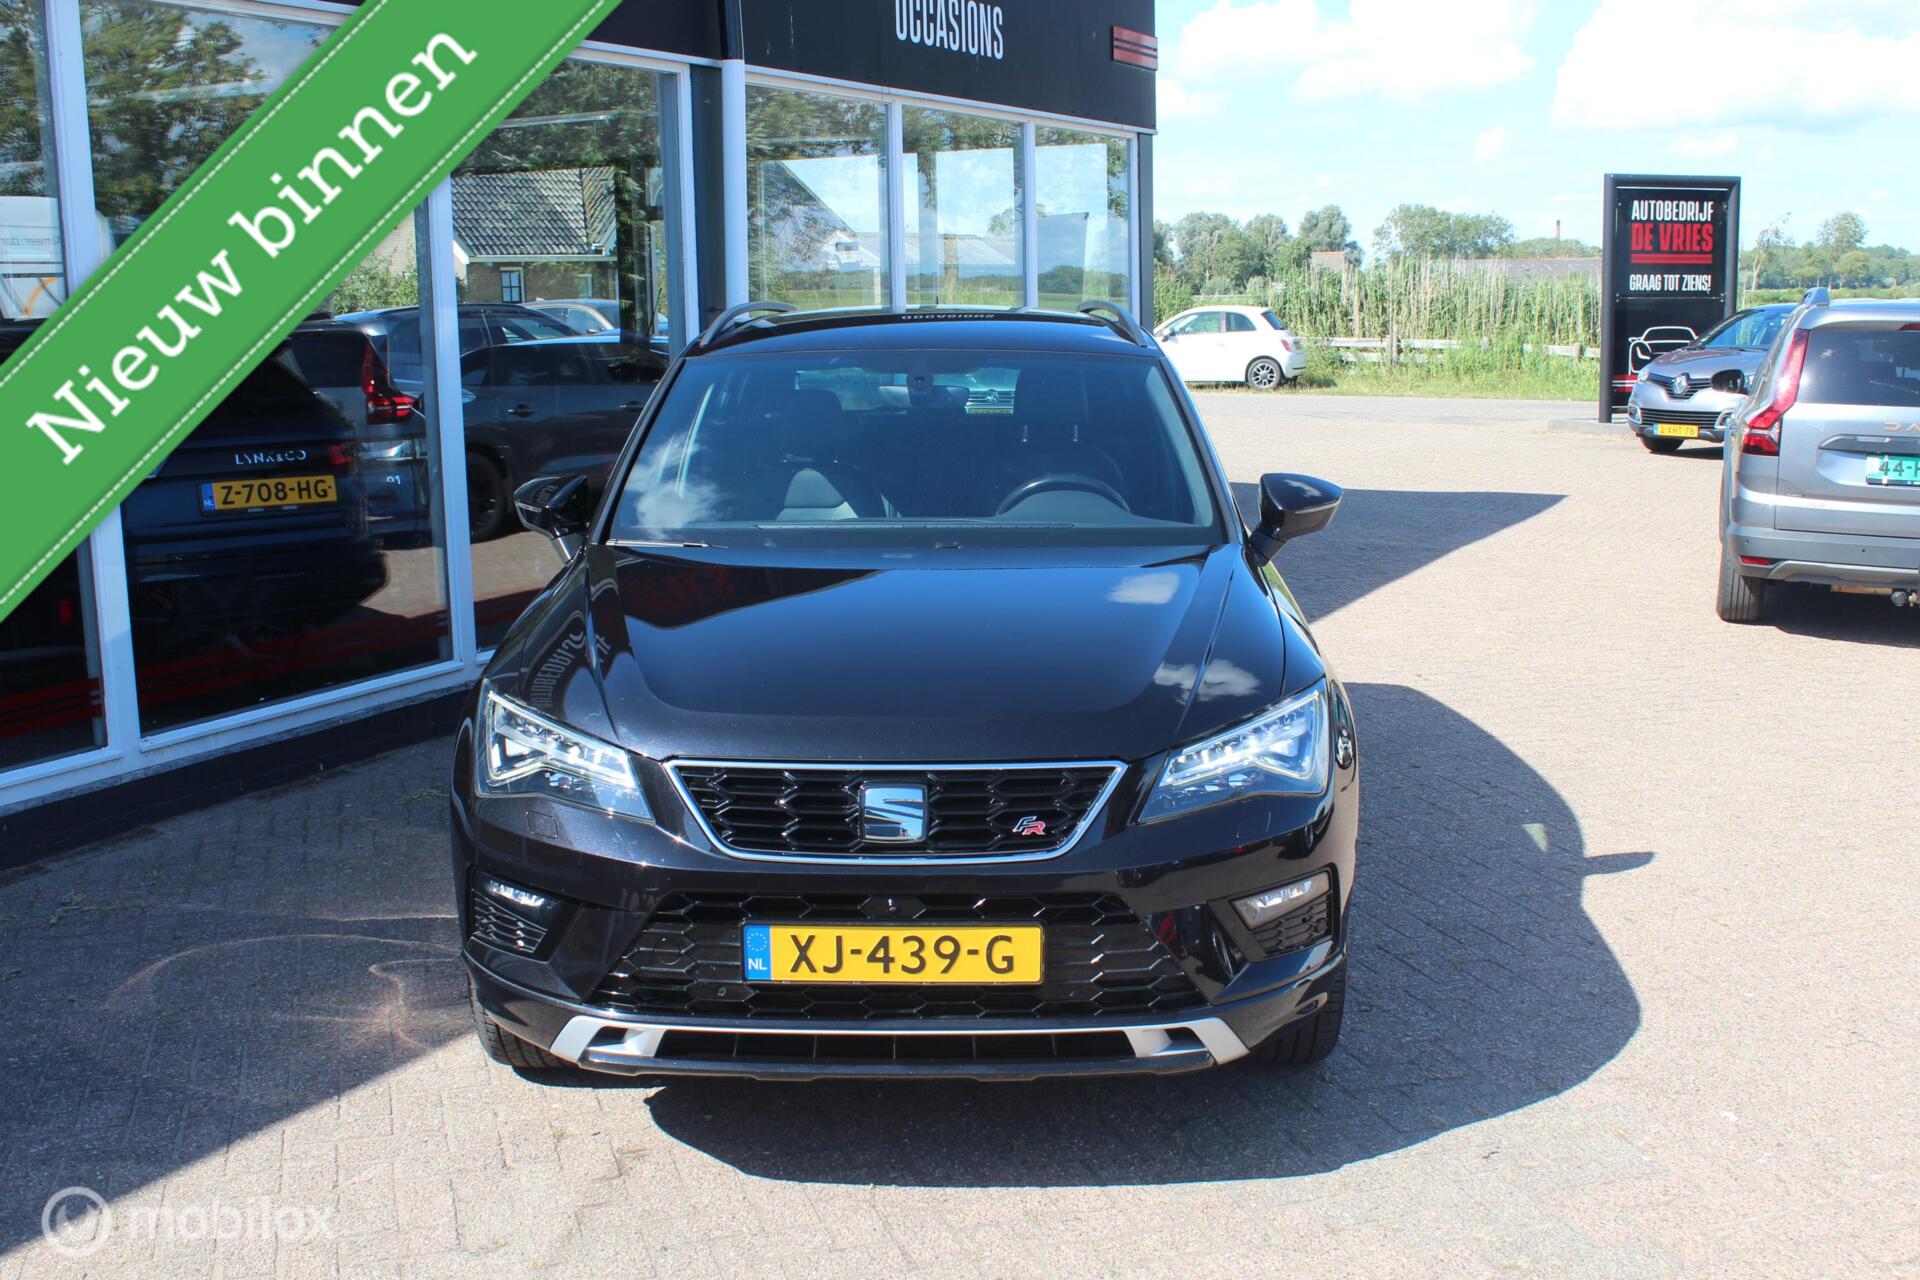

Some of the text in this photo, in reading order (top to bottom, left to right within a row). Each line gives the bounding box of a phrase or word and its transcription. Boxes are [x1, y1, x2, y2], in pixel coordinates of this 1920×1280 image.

[895, 0, 1004, 60] OCCASIONS
[1631, 200, 1714, 222] AUTOBEDRIJF
[1631, 222, 1714, 252] DE VRIES
[1629, 274, 1712, 293] GRAAG TOT ZIENS!
[1012, 815, 1047, 836] FR
[747, 934, 1015, 974] NL XJ-439-G
